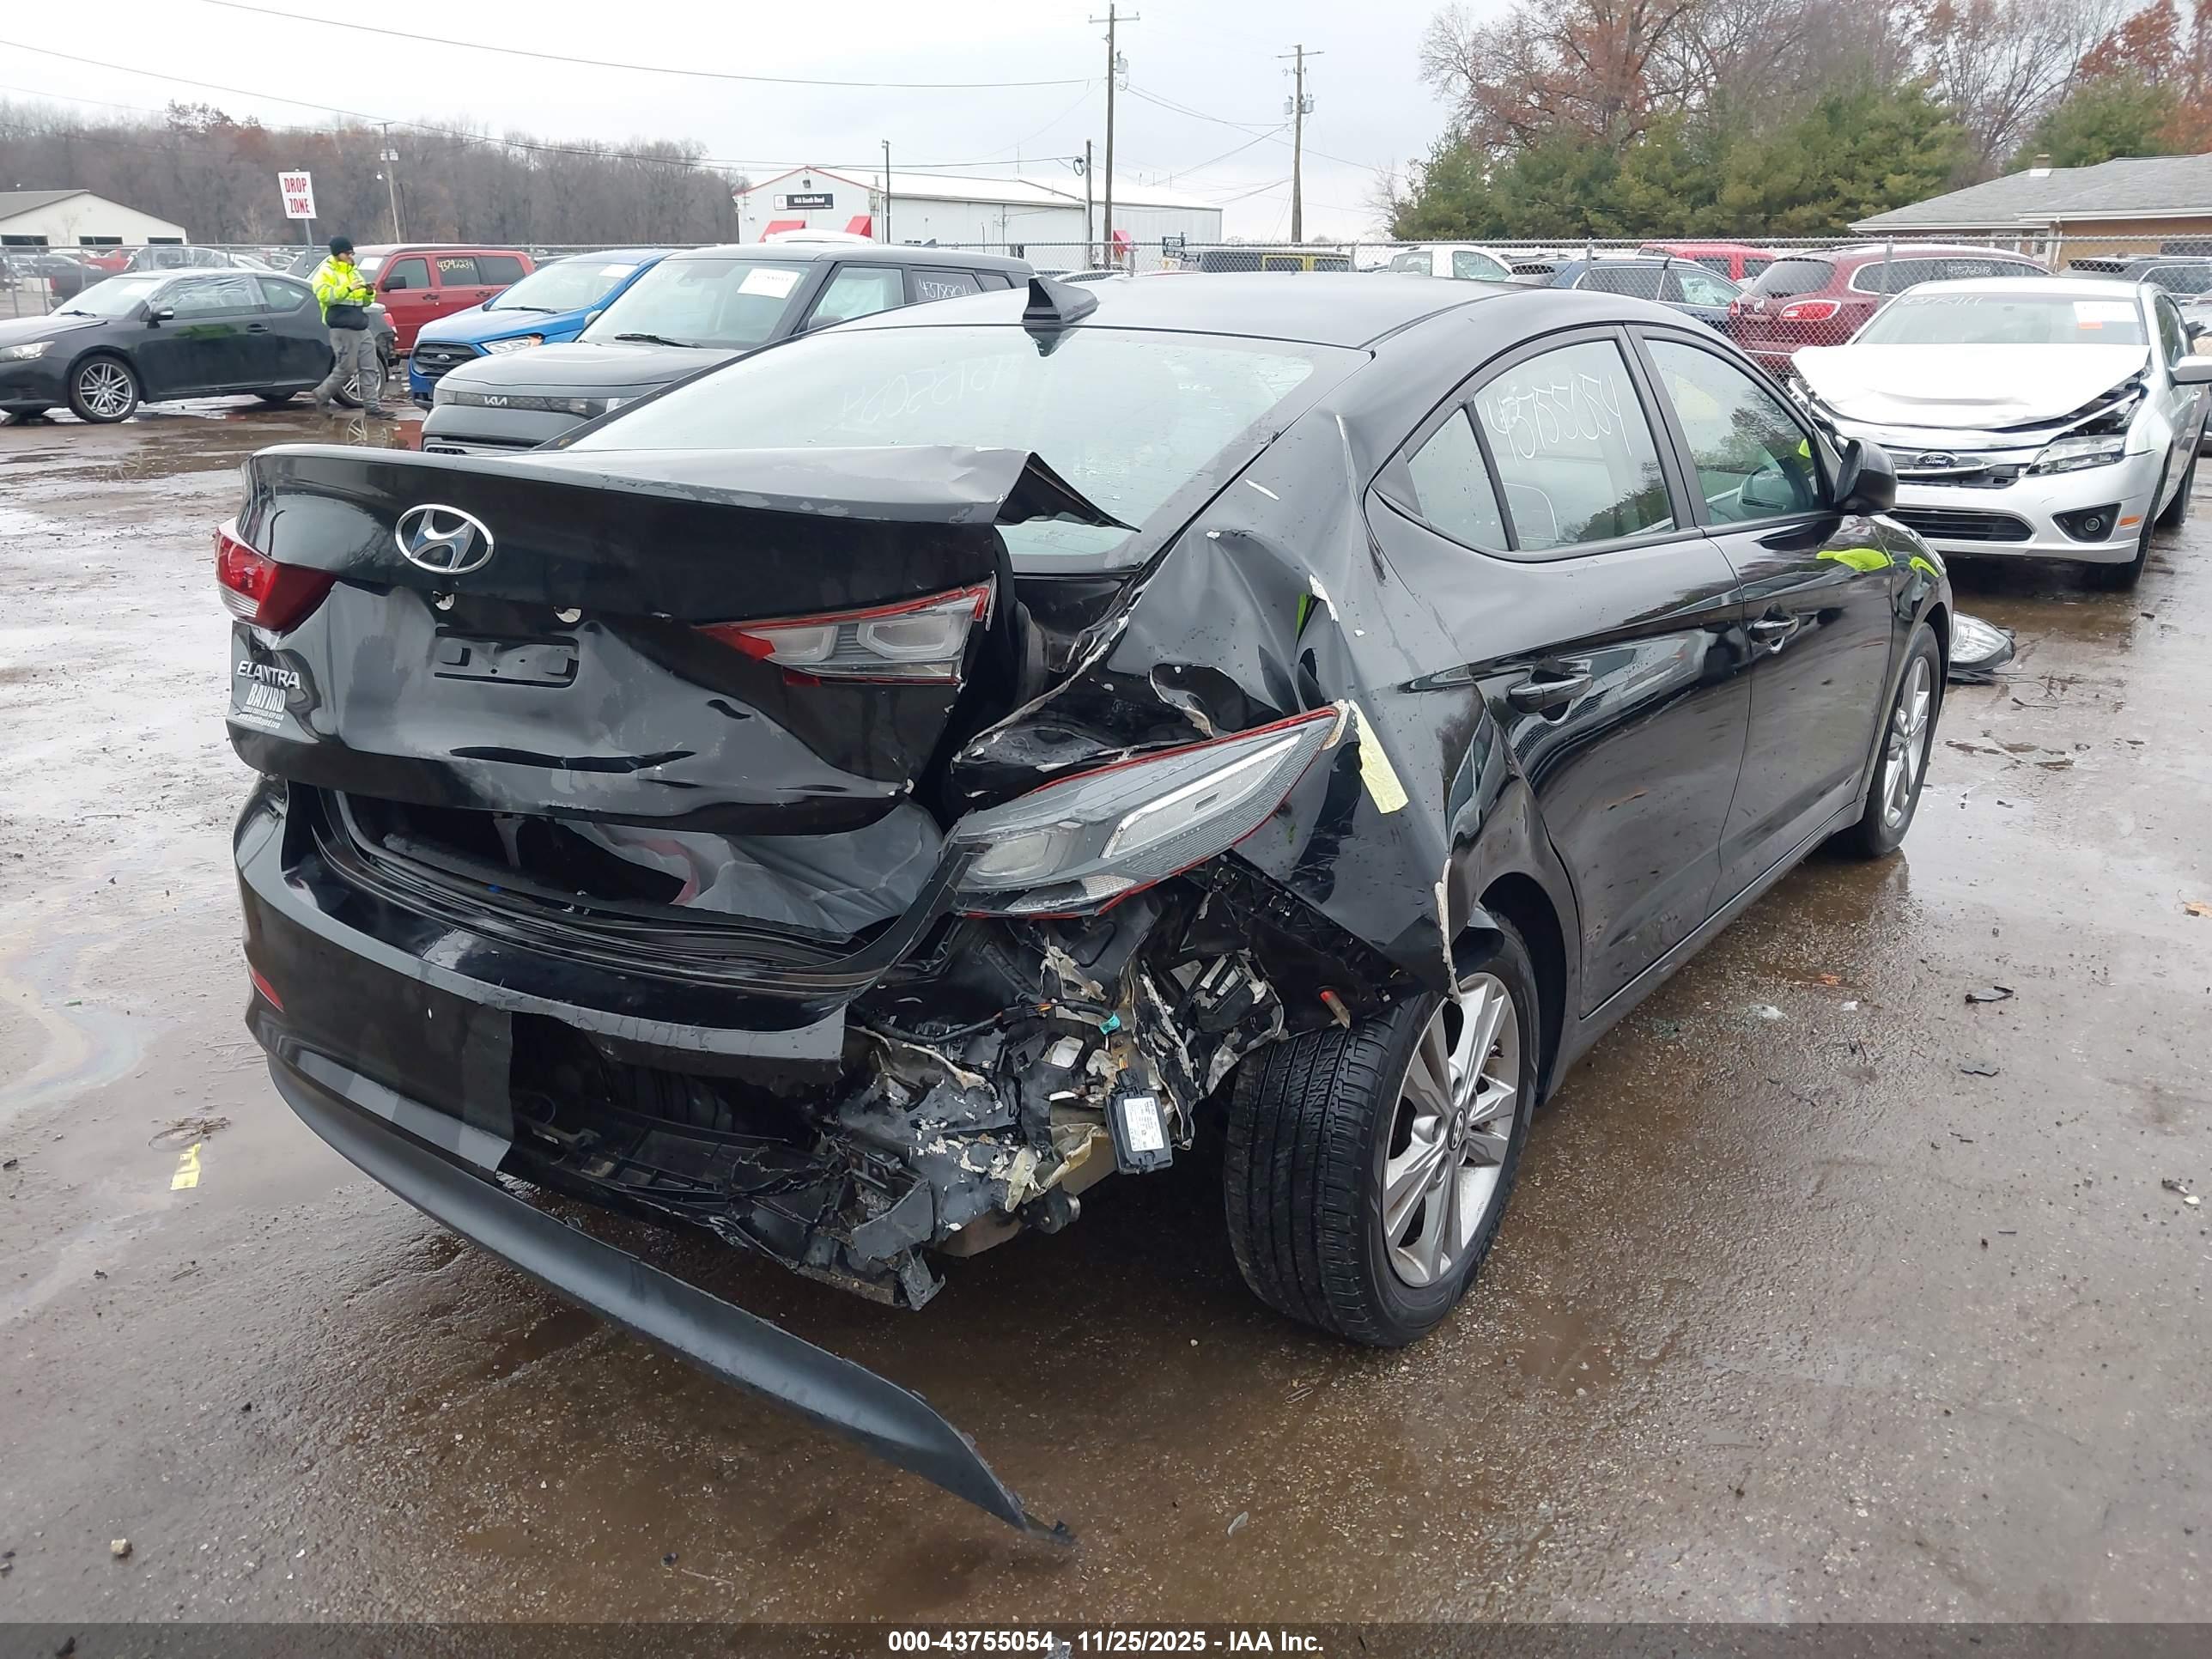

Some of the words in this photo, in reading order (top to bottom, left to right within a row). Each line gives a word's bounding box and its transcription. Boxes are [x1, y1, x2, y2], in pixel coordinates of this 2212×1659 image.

[284, 177, 307, 193] DROP
[289, 198, 310, 213] ZONE
[484, 395, 507, 405] KIA
[236, 659, 301, 690] ELANTRA
[246, 684, 286, 713] BAYIRD
